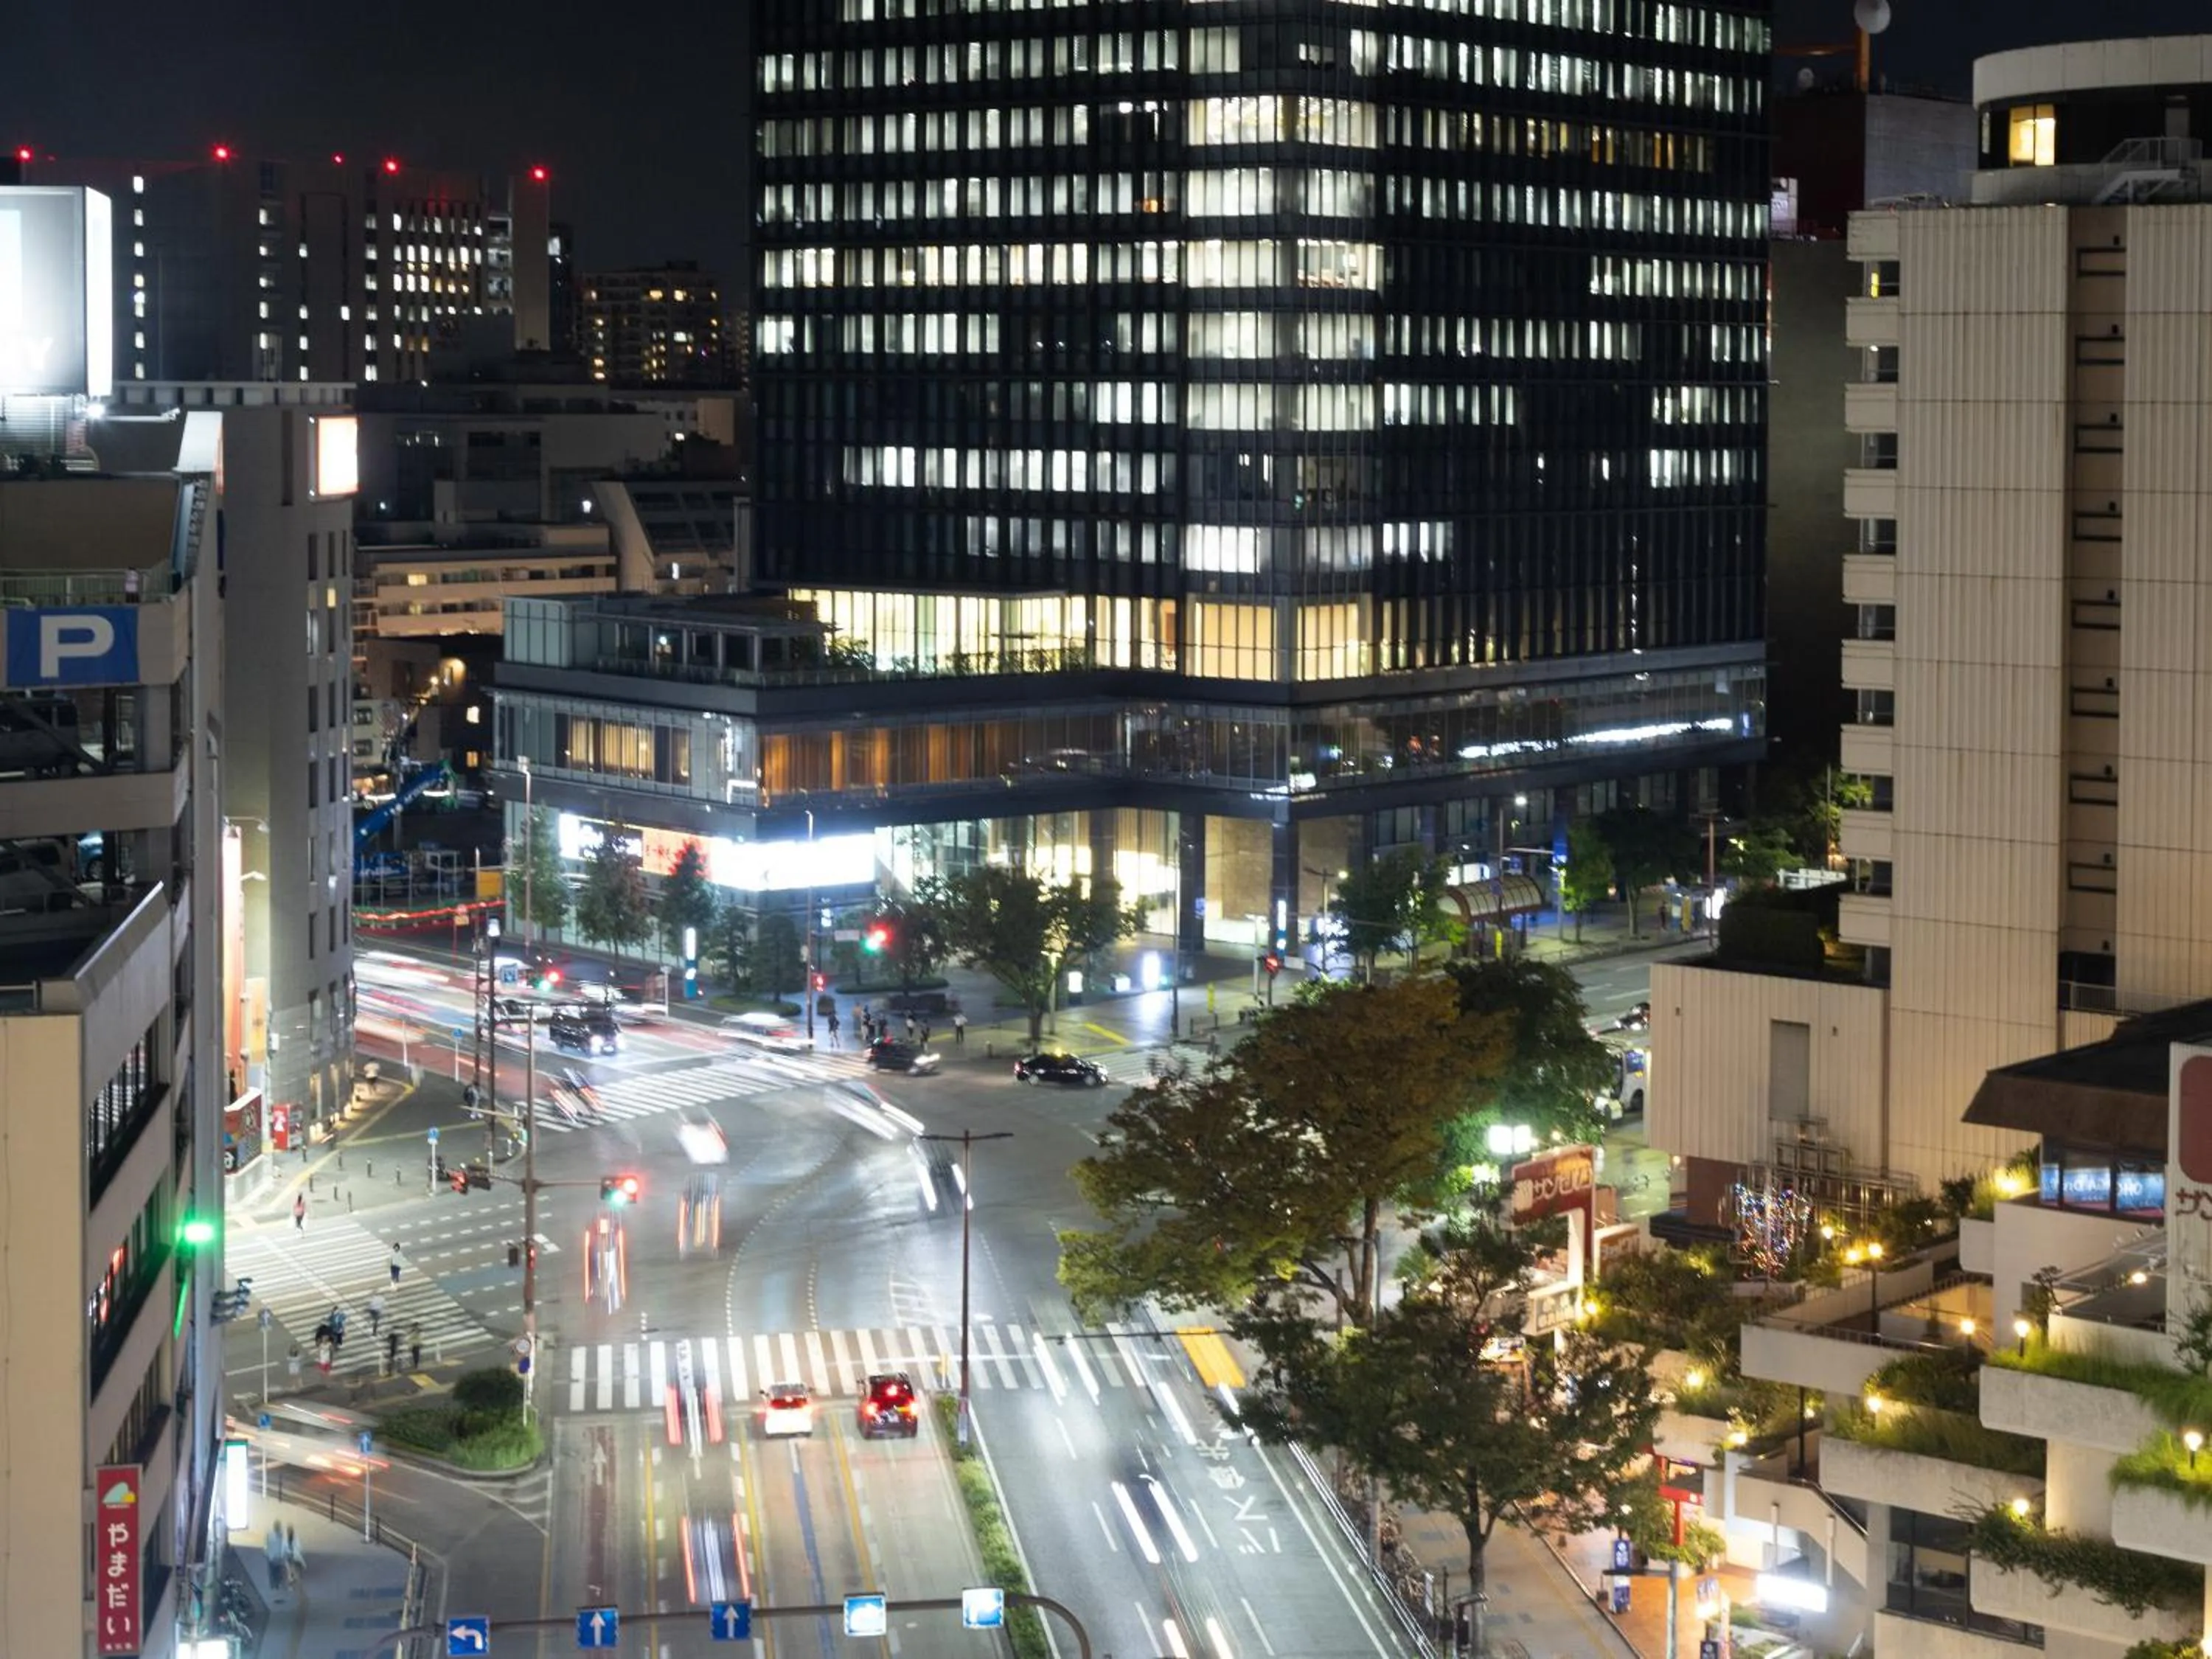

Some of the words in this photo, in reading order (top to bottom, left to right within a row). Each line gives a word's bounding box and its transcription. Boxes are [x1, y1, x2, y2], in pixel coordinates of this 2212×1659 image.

[41, 615, 114, 678] P
[106, 1522, 131, 1635] やまだい
